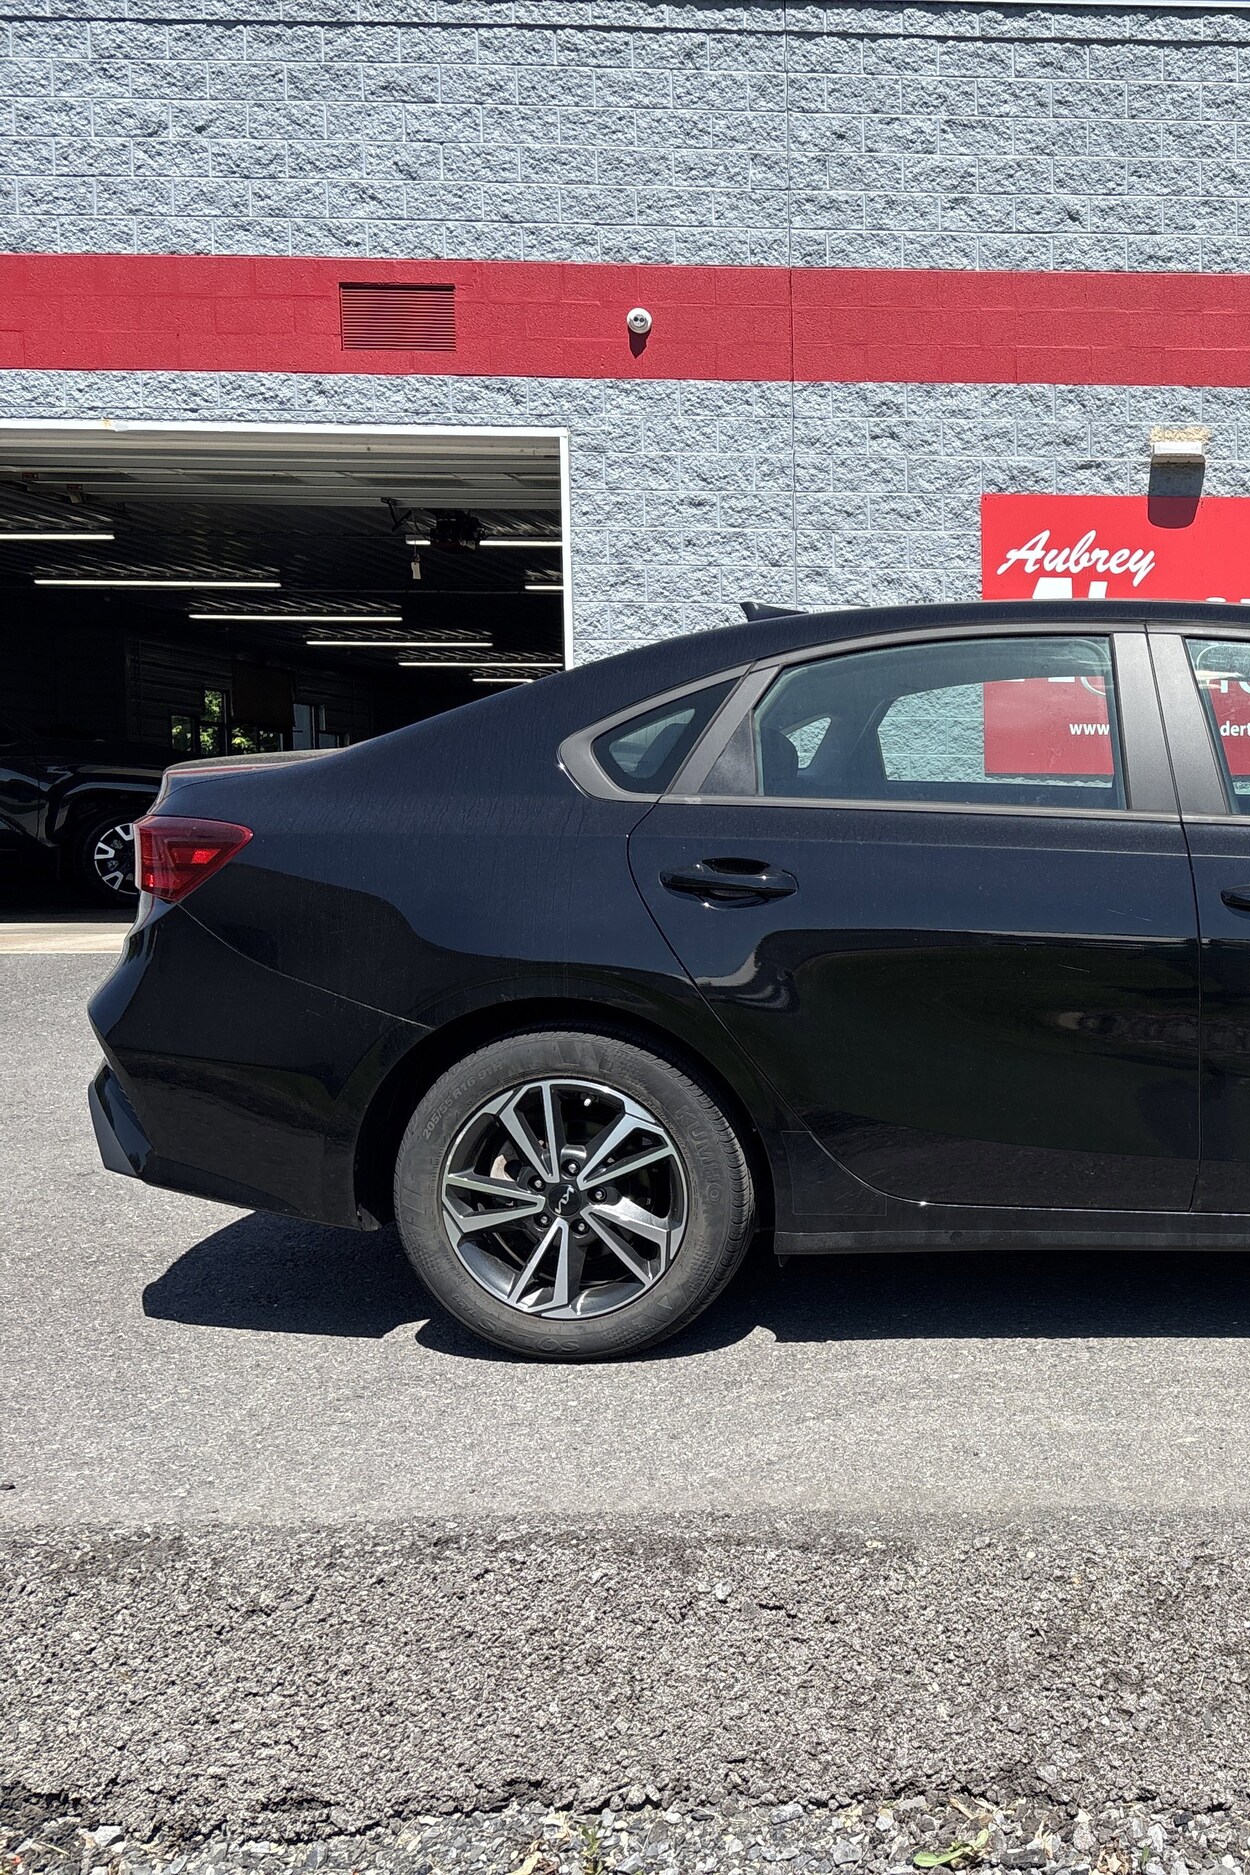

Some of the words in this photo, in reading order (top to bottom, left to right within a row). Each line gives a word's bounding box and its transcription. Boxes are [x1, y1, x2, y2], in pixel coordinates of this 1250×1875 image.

[997, 529, 1156, 587] Aubrey
[421, 1095, 456, 1140] 205/55
[452, 1076, 477, 1100] R16
[675, 1104, 722, 1205] KUMHO
